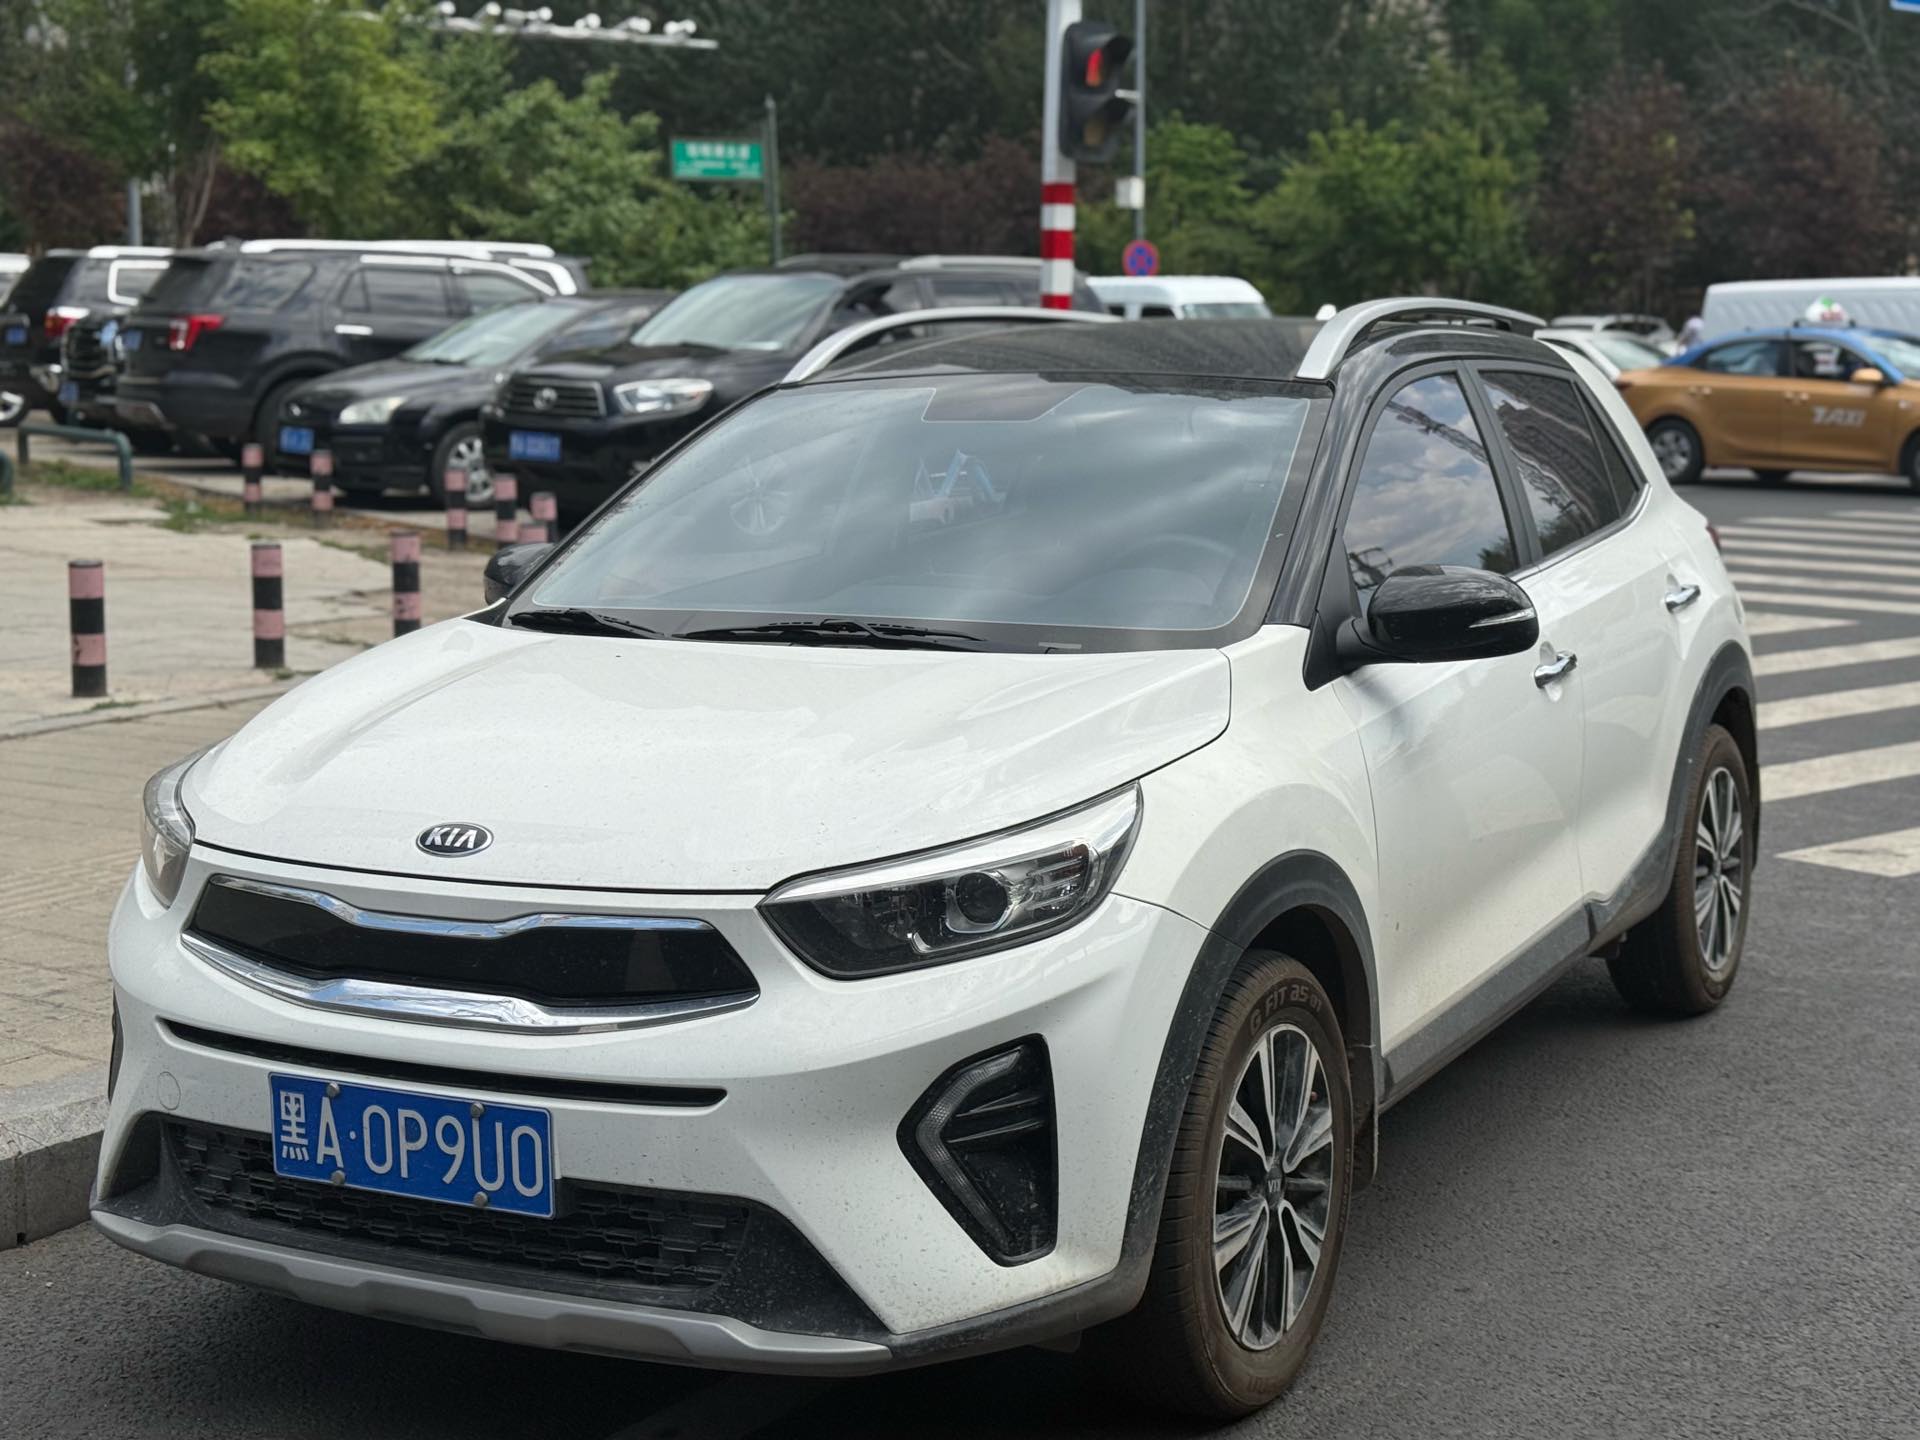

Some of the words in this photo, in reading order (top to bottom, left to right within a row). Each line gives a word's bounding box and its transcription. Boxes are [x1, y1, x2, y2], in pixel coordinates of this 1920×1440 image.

[1811, 405, 1867, 427] TAXI
[425, 827, 478, 849] KIA
[1264, 985, 1288, 1017] FIT
